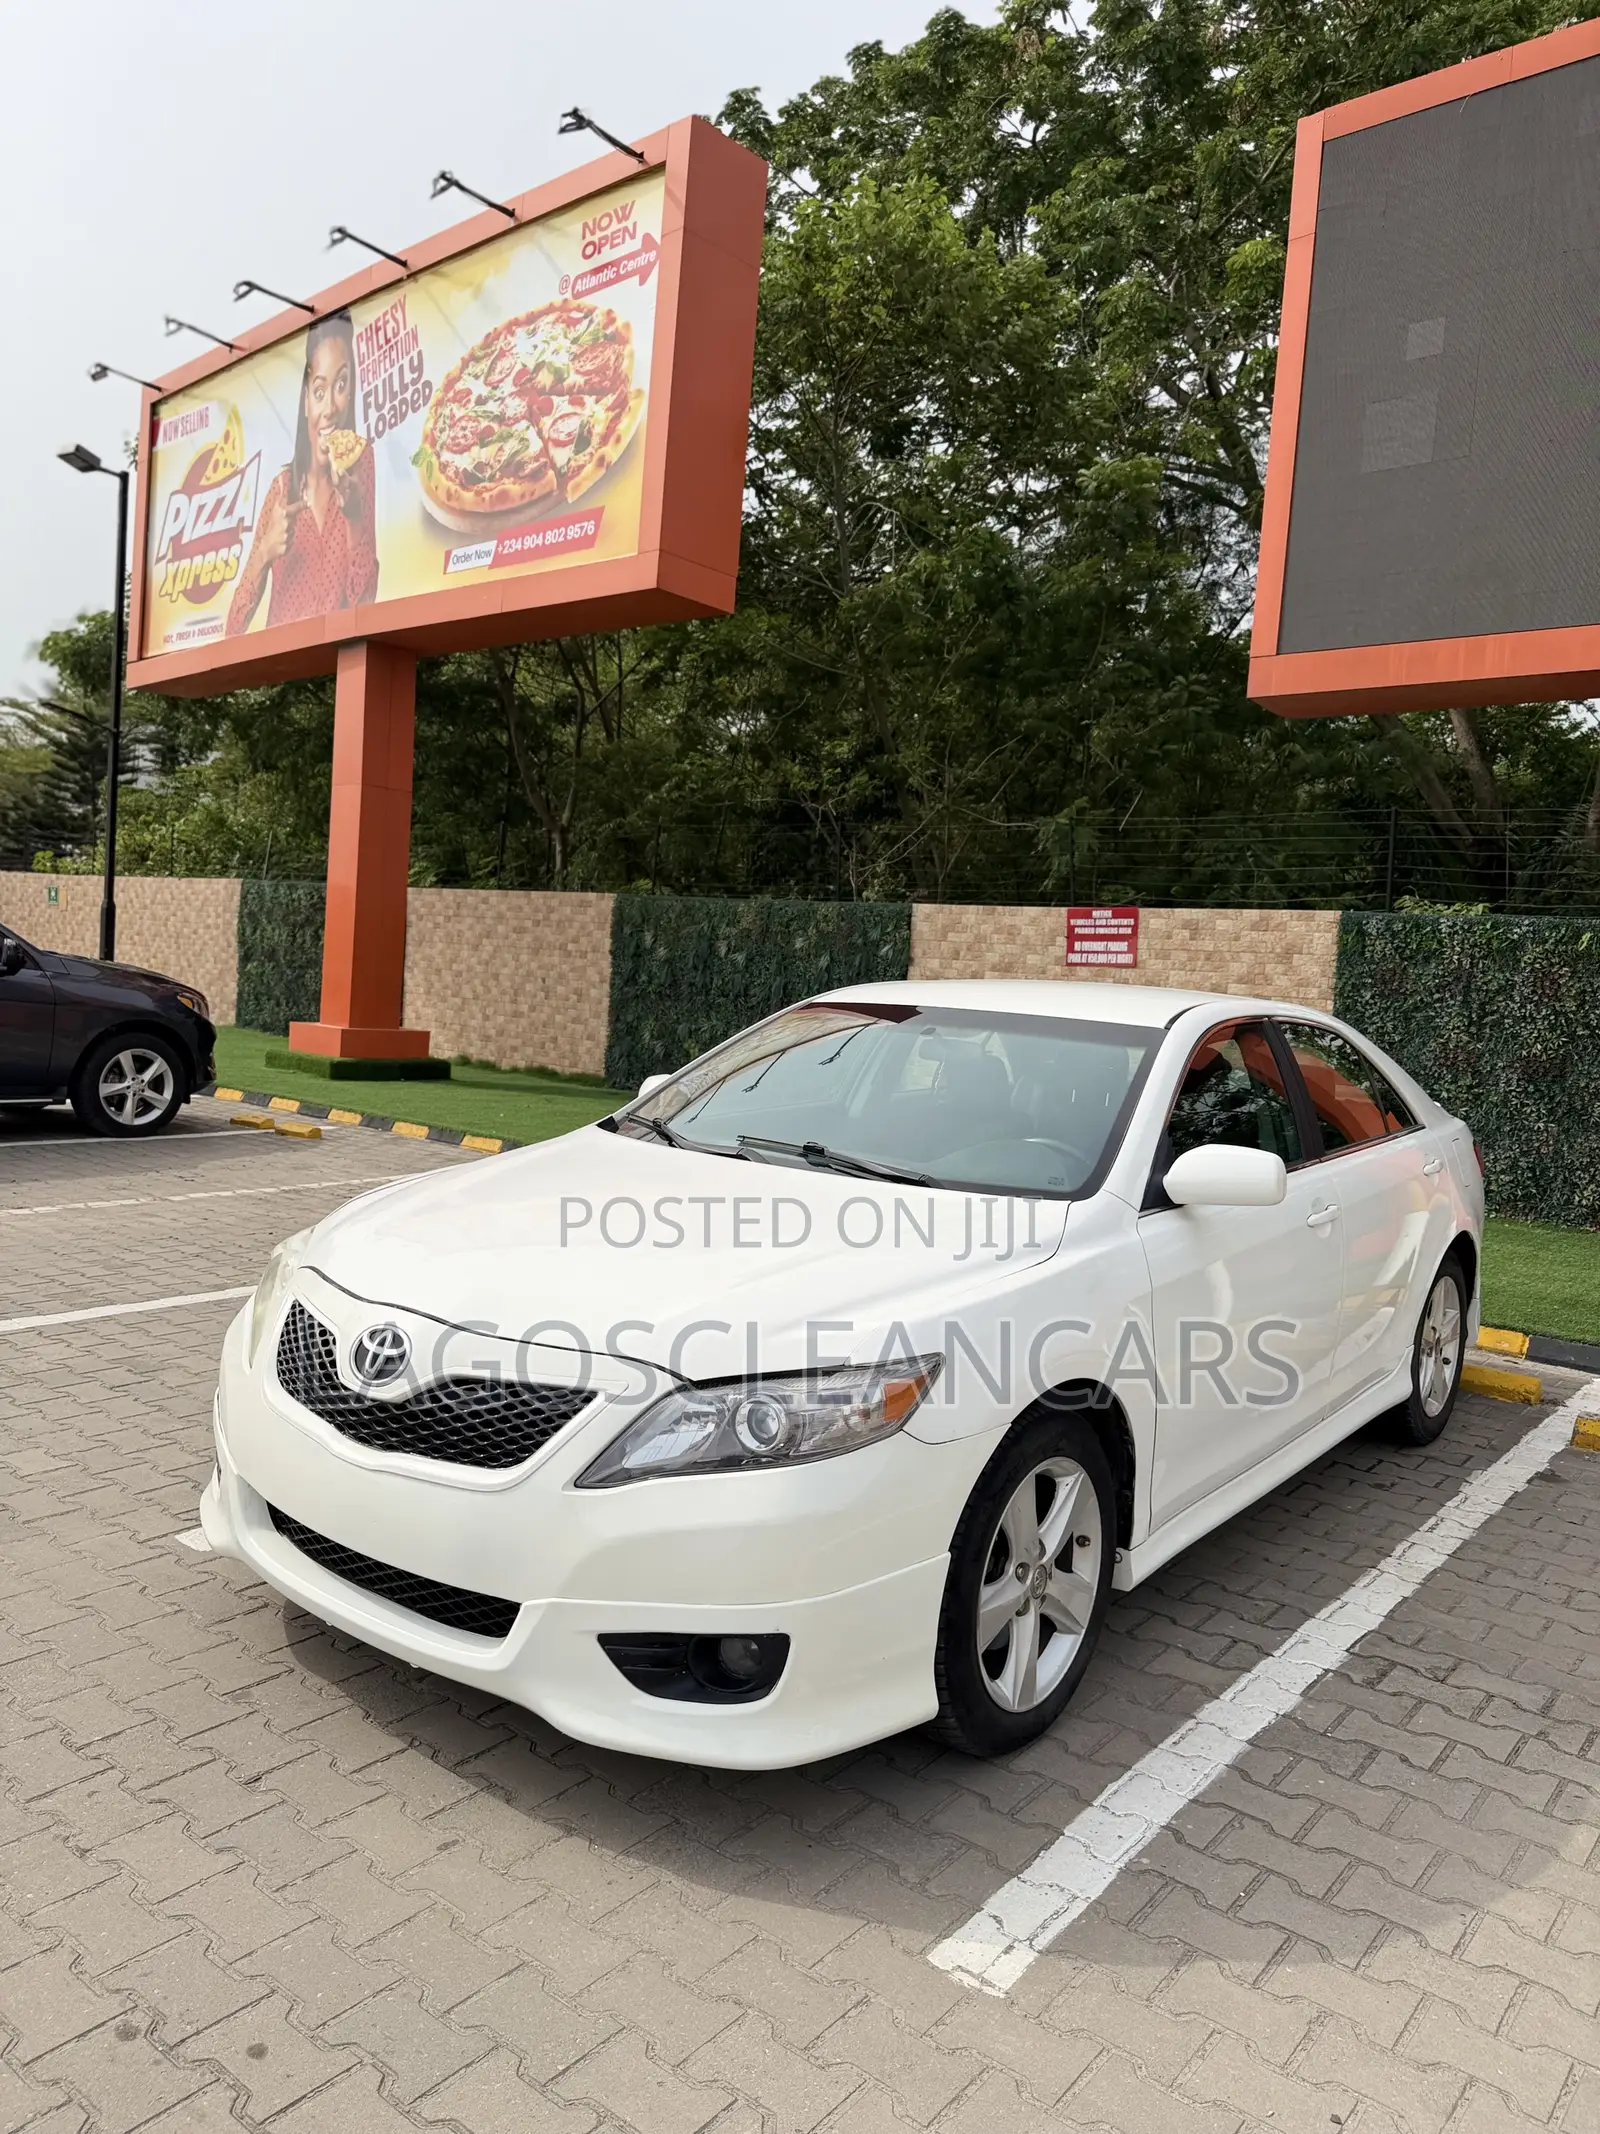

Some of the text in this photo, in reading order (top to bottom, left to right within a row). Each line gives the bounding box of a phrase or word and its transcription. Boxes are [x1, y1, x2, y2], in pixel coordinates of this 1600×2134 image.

[582, 200, 636, 240] NOW
[582, 221, 637, 260] OPEN
[559, 250, 657, 295] @ Atlantic Centre
[356, 294, 407, 368] CHEESY
[360, 324, 419, 391] PERFECTION
[363, 349, 424, 425] FULLY
[162, 406, 209, 444] NOW SELLING
[155, 450, 262, 564] PIZZA
[452, 520, 595, 565] Order Now +234 904 802 9576
